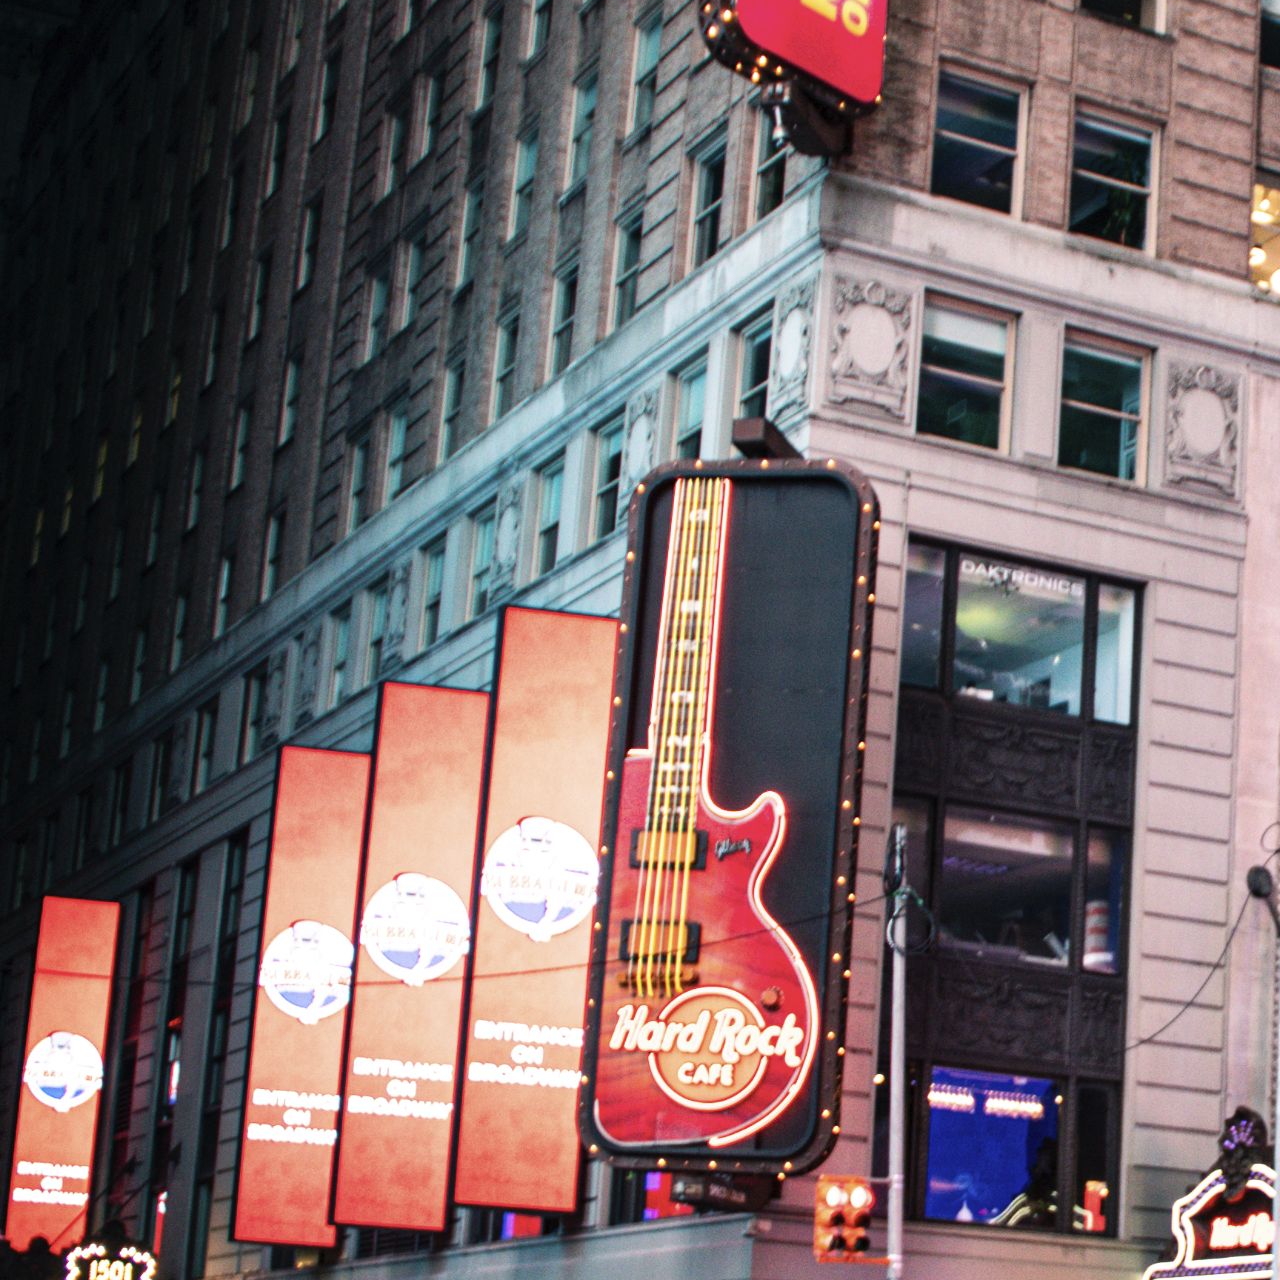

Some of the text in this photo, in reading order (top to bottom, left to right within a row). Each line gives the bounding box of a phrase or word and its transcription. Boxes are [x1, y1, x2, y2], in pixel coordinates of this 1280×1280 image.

[961, 559, 1084, 596] DAKTRONICS
[474, 1020, 584, 1047] ENTRANCE
[609, 1004, 805, 1068] Hard Rock
[511, 1044, 544, 1065] ON
[353, 1057, 454, 1082] ENTRANCE
[468, 1062, 582, 1089] BROADWAY
[677, 1061, 735, 1086] CAFE
[386, 1079, 417, 1098] ON
[283, 1109, 311, 1126] ON
[347, 1095, 454, 1120] BROADWAY
[247, 1123, 338, 1146] BROADWAY
[17, 1161, 89, 1179] ENTRANCE
[13, 1187, 89, 1207] BROADWAY
